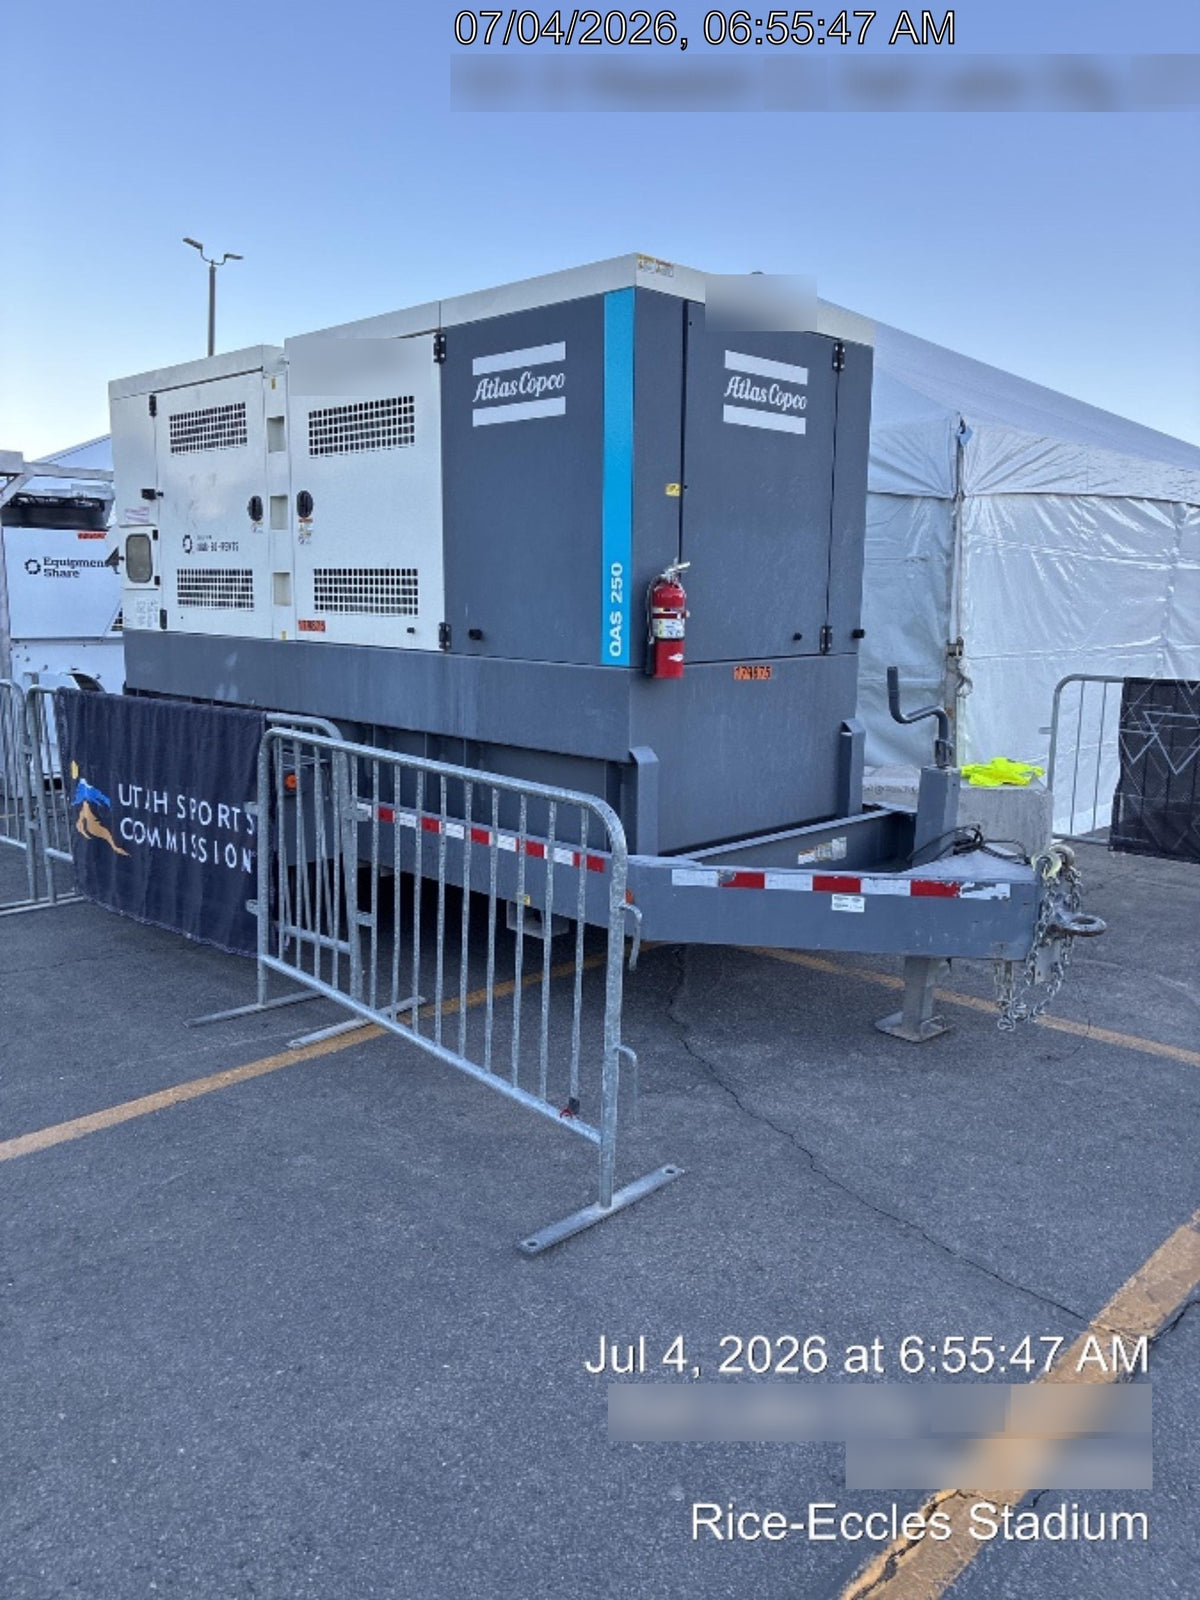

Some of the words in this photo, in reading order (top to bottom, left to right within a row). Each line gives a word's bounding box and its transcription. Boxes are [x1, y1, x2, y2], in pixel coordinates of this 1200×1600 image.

[472, 377, 518, 403] Atlas
[519, 371, 565, 398] Copco
[723, 376, 768, 403] Atlas
[769, 383, 808, 412] Copco
[43, 556, 106, 568] Equipmen
[43, 568, 80, 578] Share
[611, 562, 623, 604] 250
[176, 794, 255, 835] SPORTS
[120, 817, 252, 874] COMMISSION
